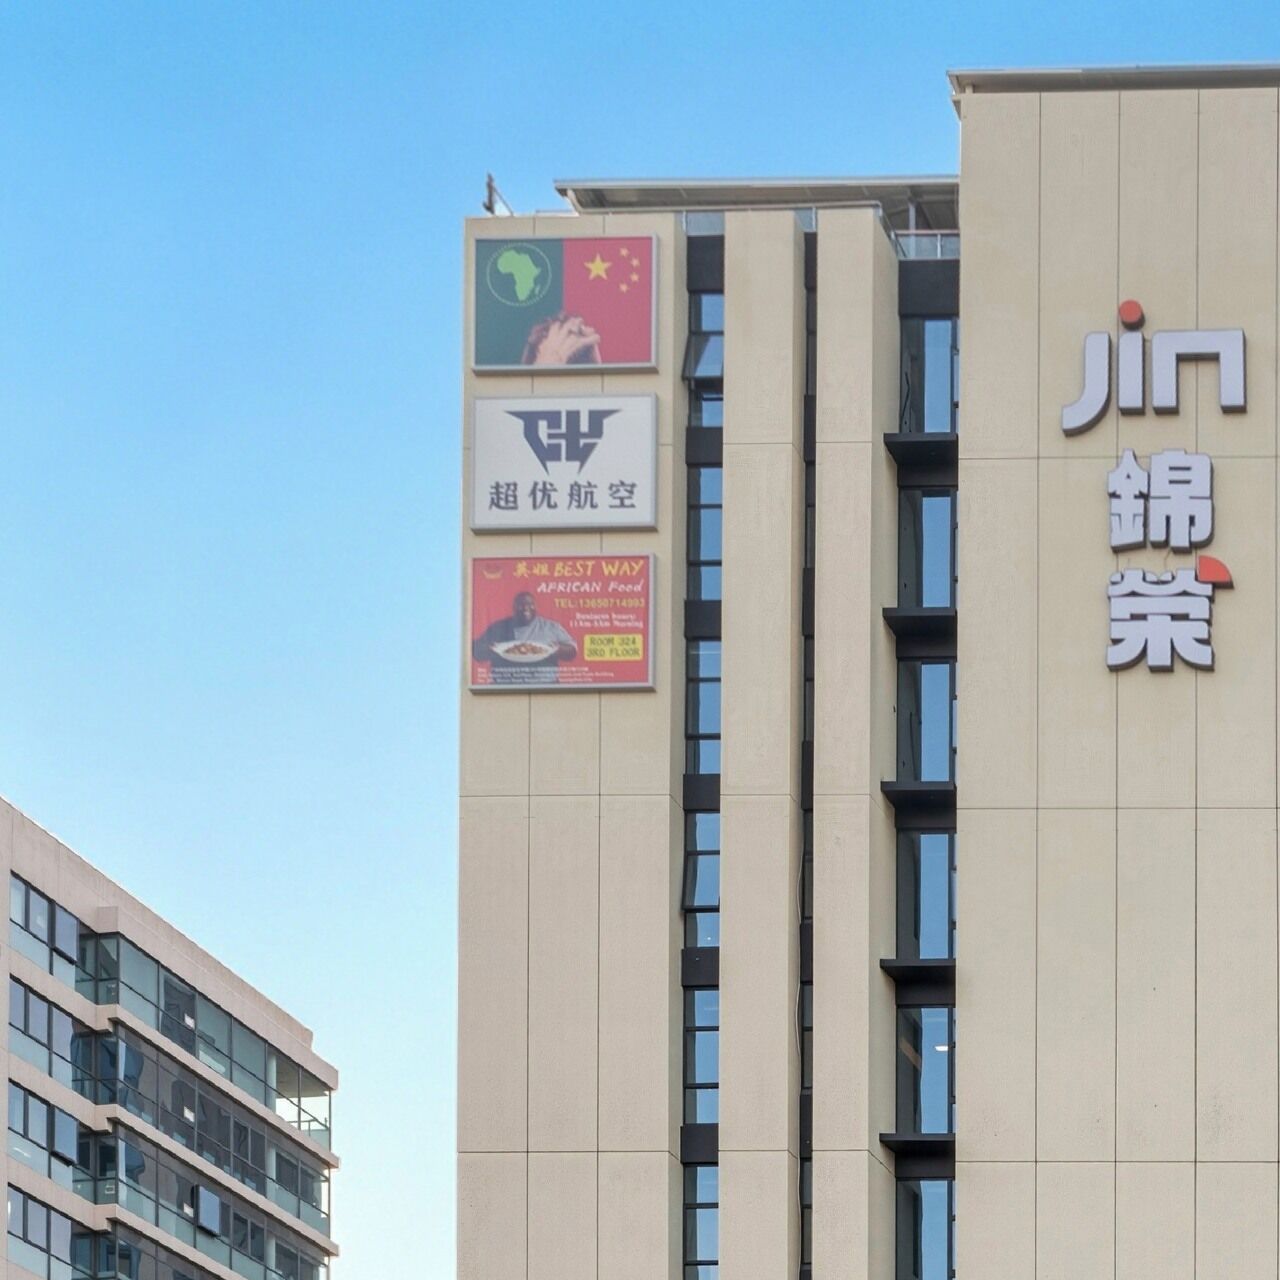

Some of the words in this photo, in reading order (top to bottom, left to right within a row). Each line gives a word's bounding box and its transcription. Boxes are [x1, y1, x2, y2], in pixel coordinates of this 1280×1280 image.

[1062, 299, 1247, 437] jin
[488, 480, 638, 511] 超优航空
[554, 560, 595, 577] BEST
[602, 560, 644, 577] WAY
[537, 581, 601, 593] AFRICAN
[608, 579, 644, 593] Food
